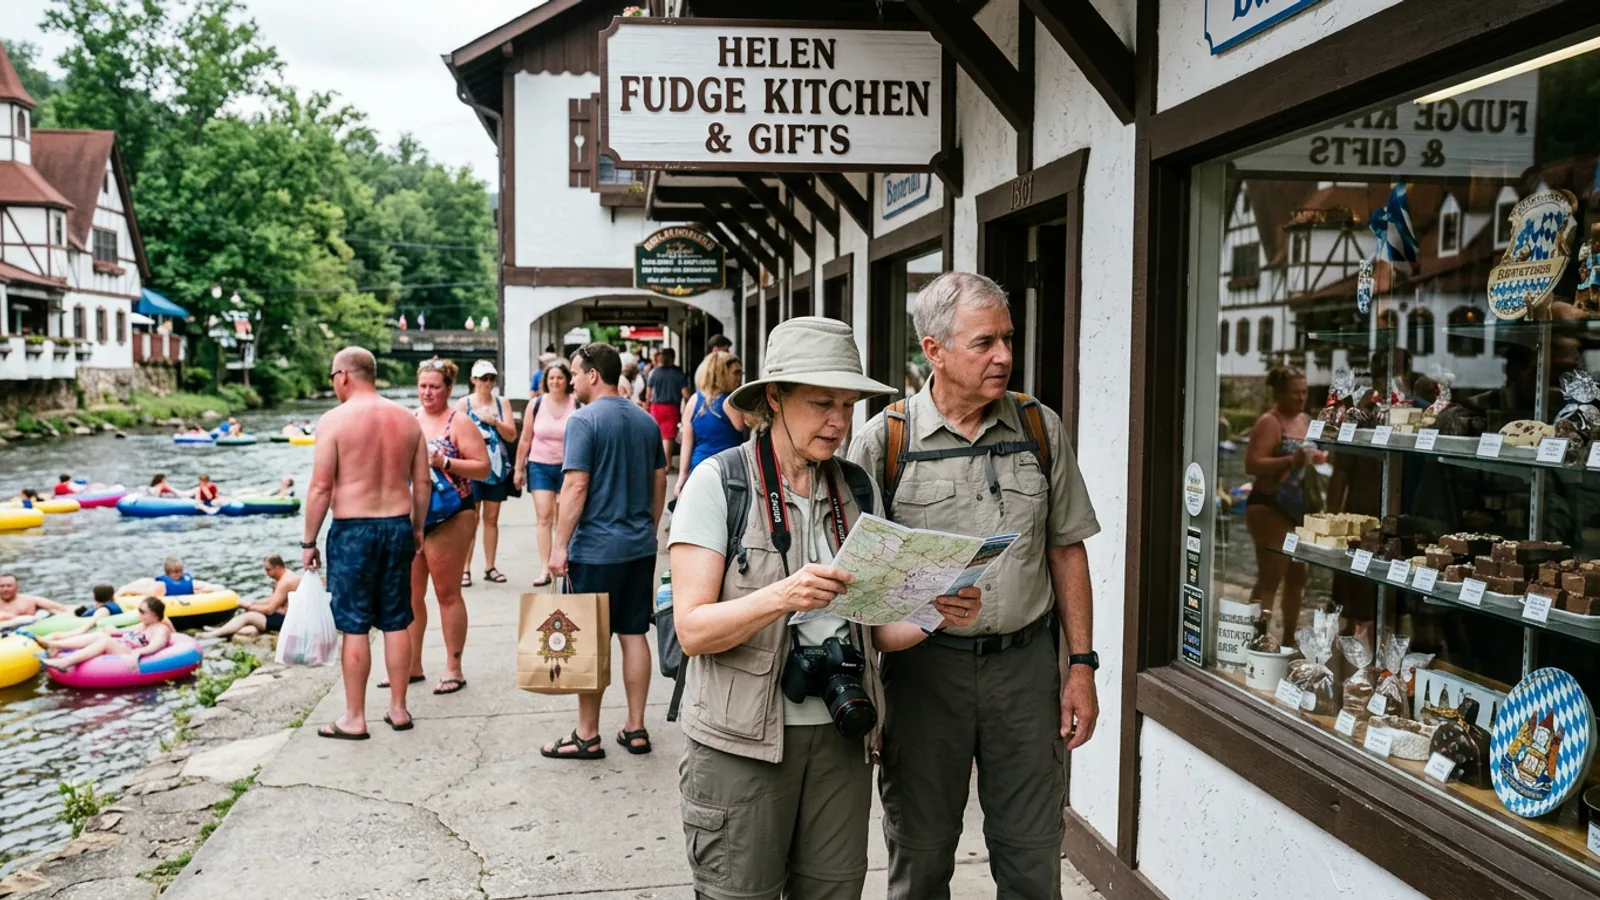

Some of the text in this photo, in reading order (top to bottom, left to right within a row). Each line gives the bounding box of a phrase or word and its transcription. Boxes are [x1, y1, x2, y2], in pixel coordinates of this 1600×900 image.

[718, 36, 836, 69] HELEN
[620, 76, 931, 117] FUDGE KITCHEN
[705, 122, 850, 155] & GIFTS
